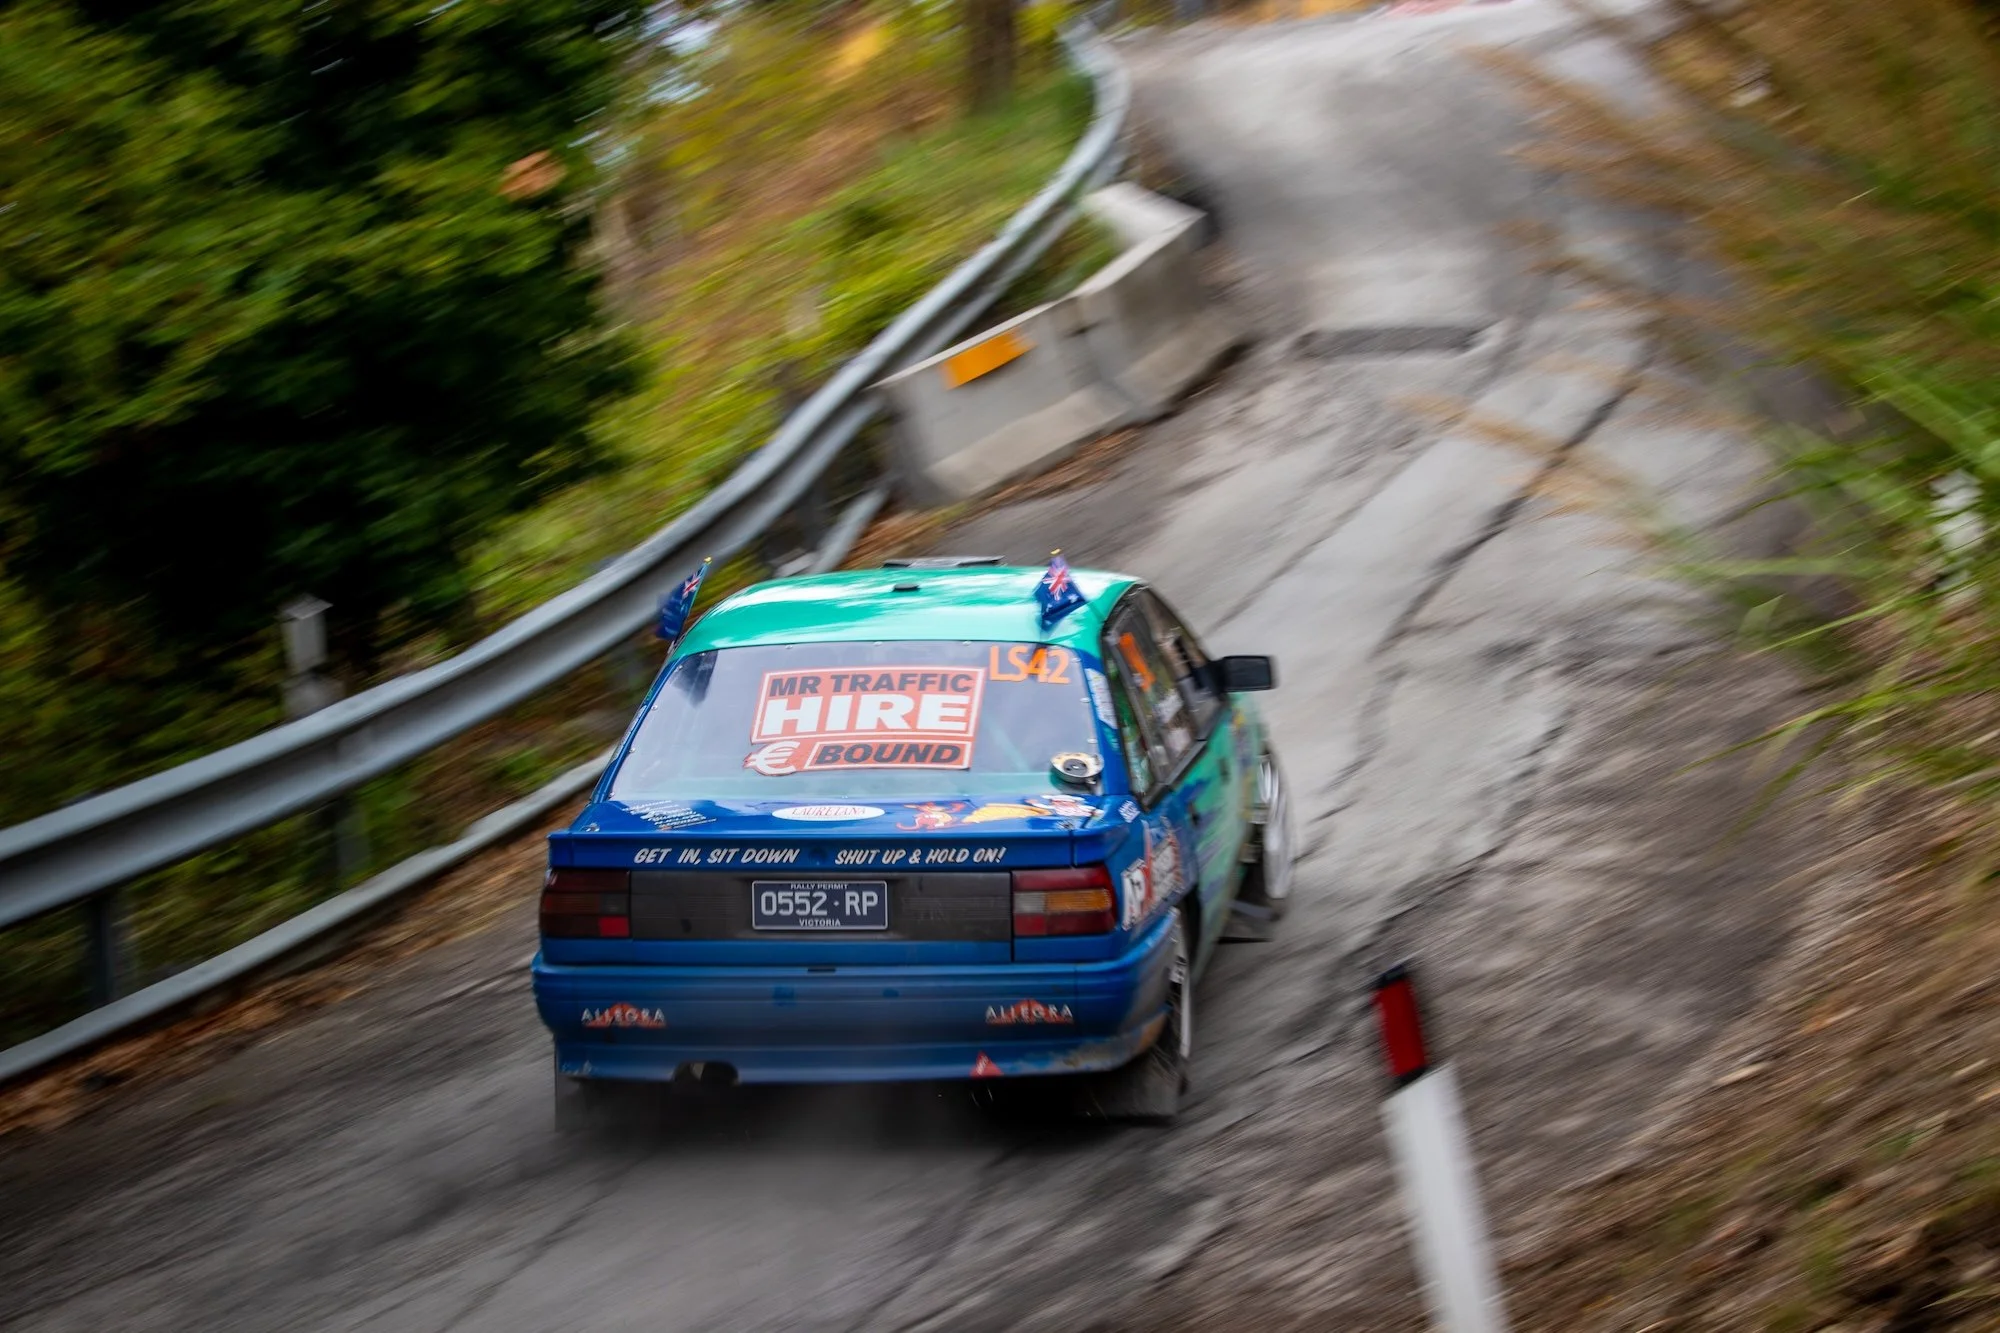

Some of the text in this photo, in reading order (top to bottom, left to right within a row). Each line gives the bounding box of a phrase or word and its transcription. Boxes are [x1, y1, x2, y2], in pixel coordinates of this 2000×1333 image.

[988, 645, 1071, 684] LS42
[769, 672, 974, 697] MR TRAFFIC
[760, 694, 967, 736] HIRE
[815, 743, 961, 766] BOUND
[633, 848, 672, 864] GET
[707, 848, 740, 864] SIT
[740, 848, 800, 864] DOWN
[835, 846, 1006, 865] SHUT UP & HOLD ON!
[799, 918, 841, 928] VICTORIA
